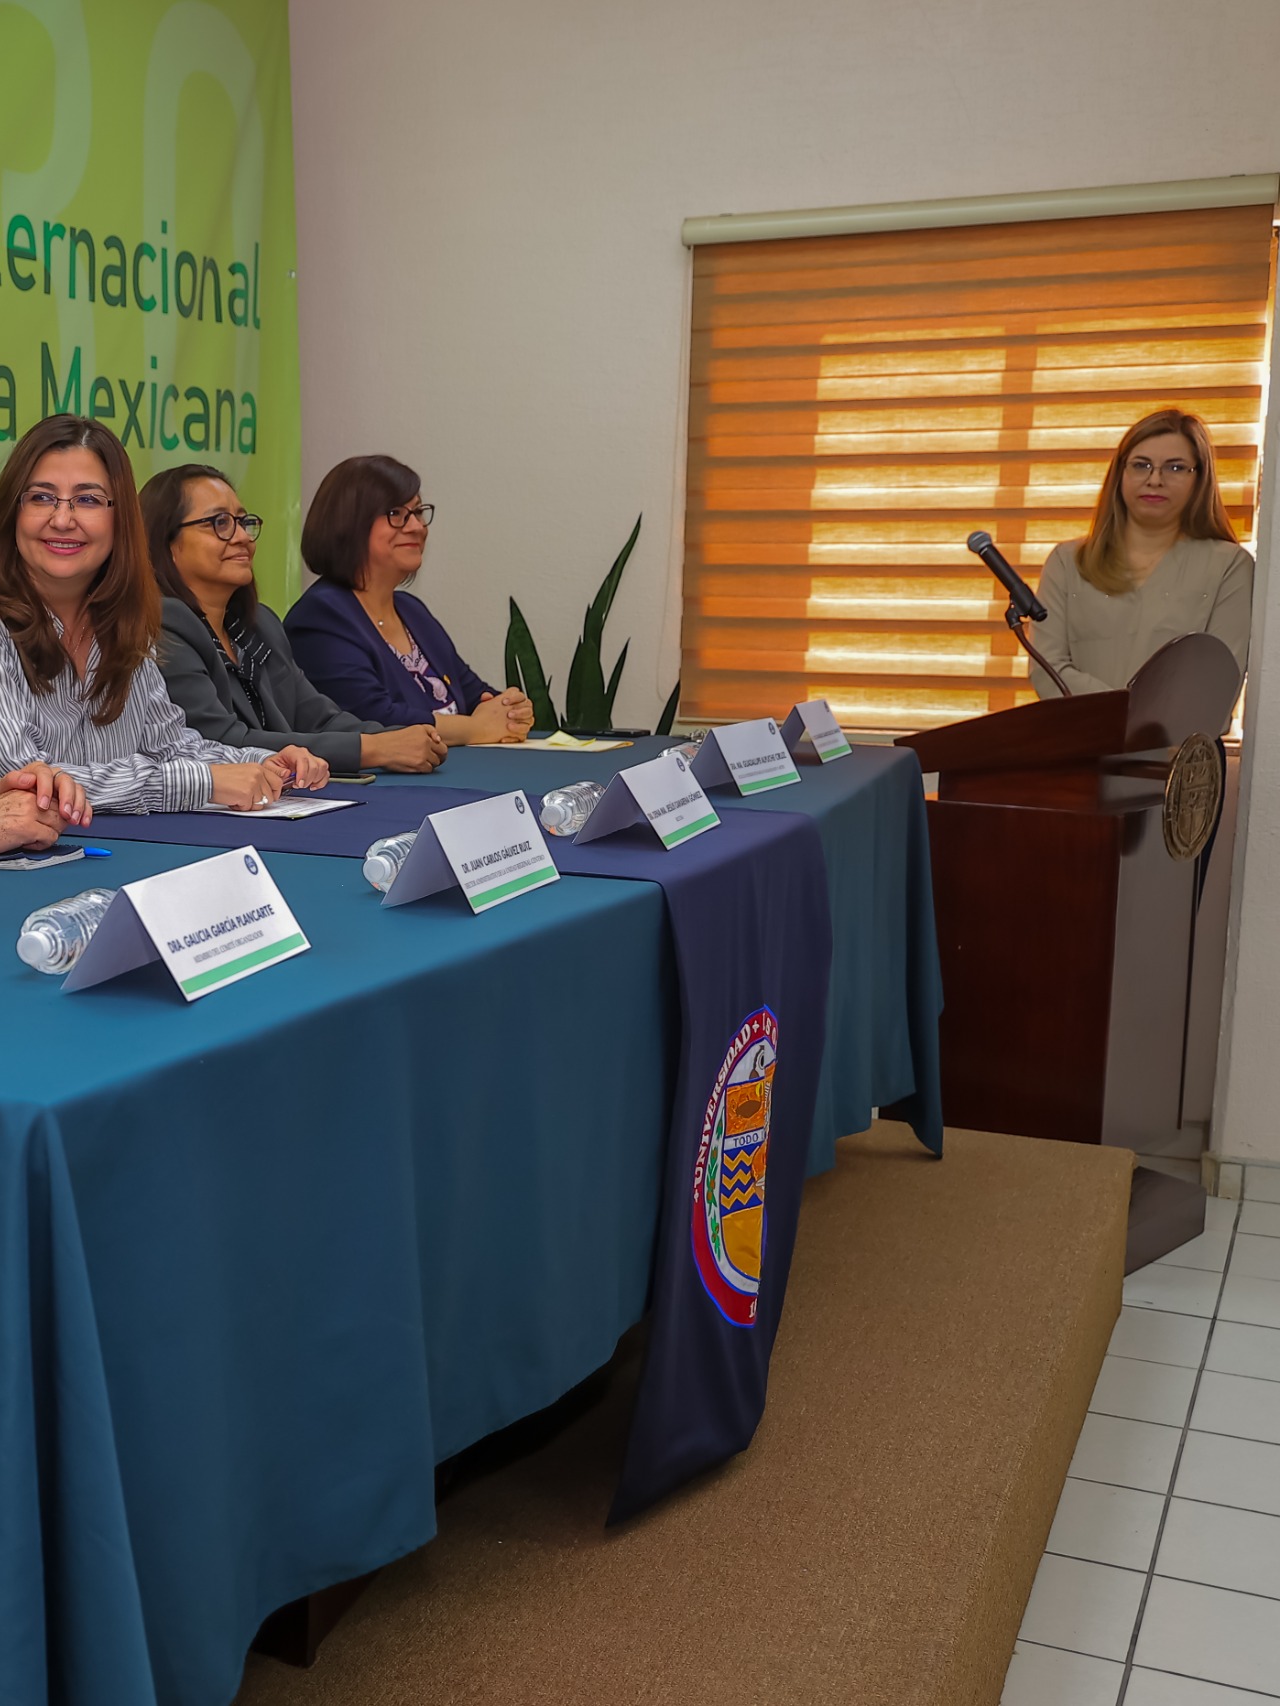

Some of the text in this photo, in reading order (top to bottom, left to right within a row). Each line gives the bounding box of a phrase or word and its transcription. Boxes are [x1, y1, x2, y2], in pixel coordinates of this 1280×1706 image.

[41, 342, 257, 454] Mexicana
[461, 841, 532, 873] DR. JUAN CARLOS GÁLVEZ RUIZ
[167, 904, 275, 953] DRA. GALICIA GARCÍA PLANCARTE
[694, 1023, 751, 1188] UNIVERSIDAD
[733, 1132, 758, 1147] TODO
